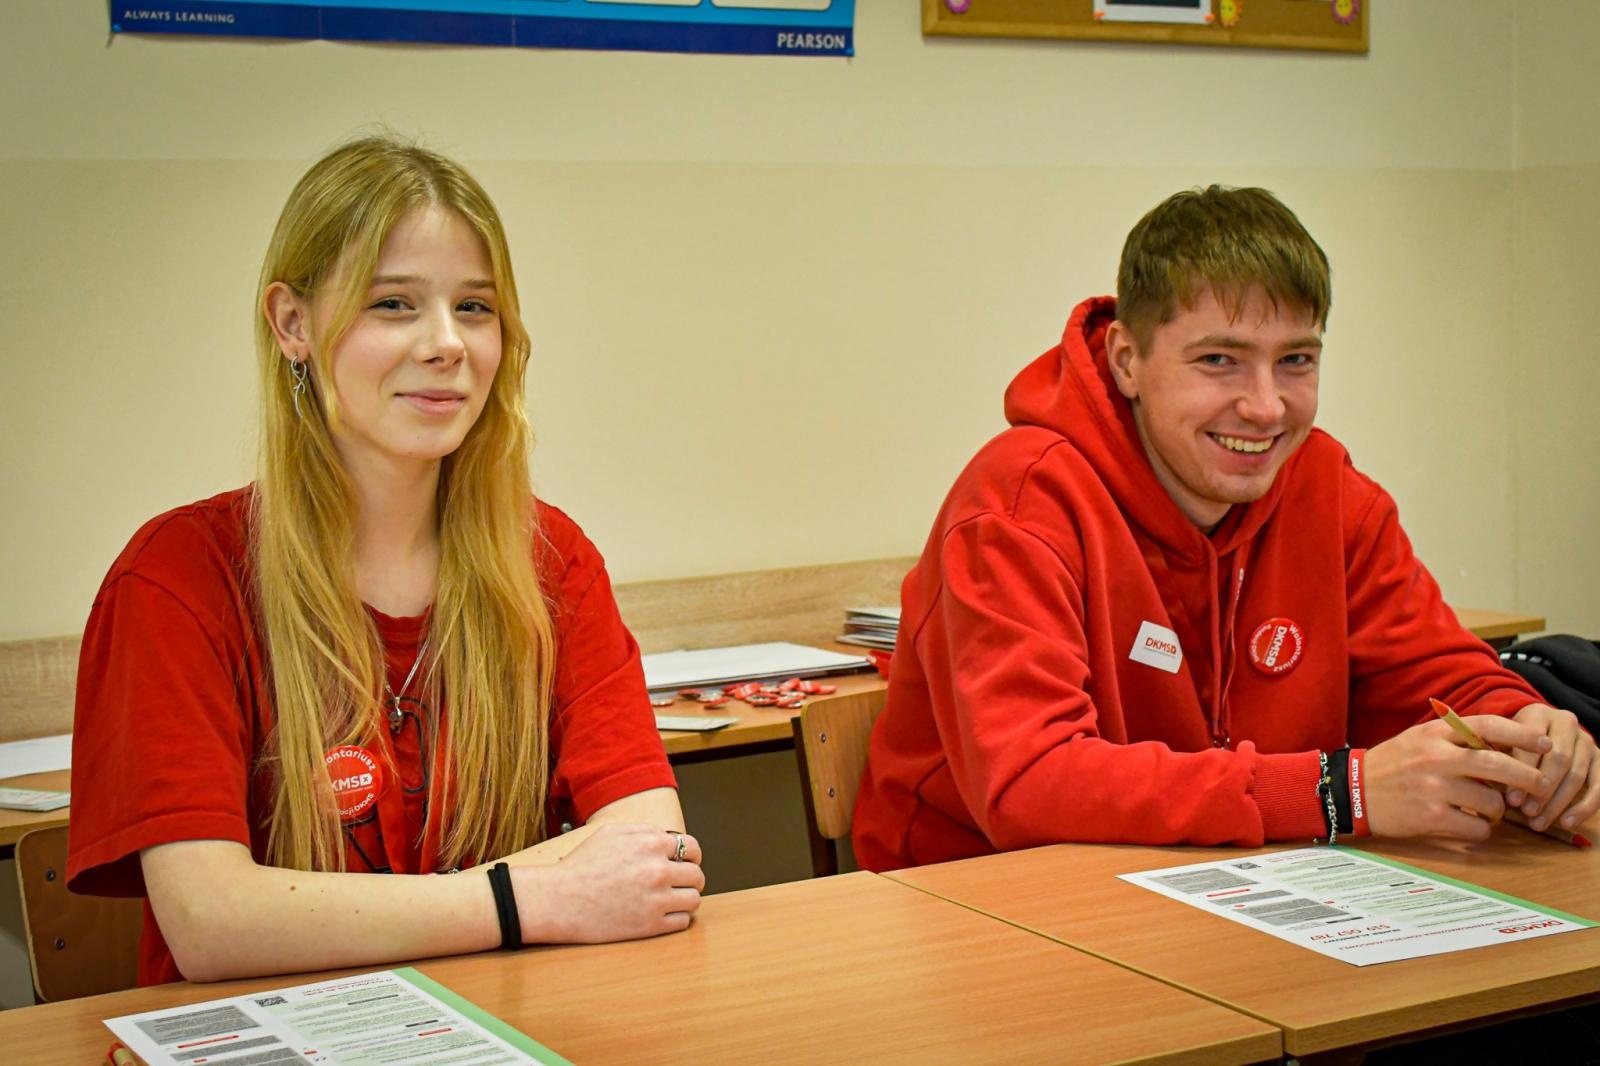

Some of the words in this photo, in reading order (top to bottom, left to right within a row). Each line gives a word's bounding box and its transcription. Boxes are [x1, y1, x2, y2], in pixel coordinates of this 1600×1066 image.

[124, 10, 171, 21] ALWAYS
[175, 12, 235, 23] LEARNING
[777, 32, 845, 49] PEARSON
[326, 749, 376, 771] ontariusz
[332, 775, 361, 792] KMS
